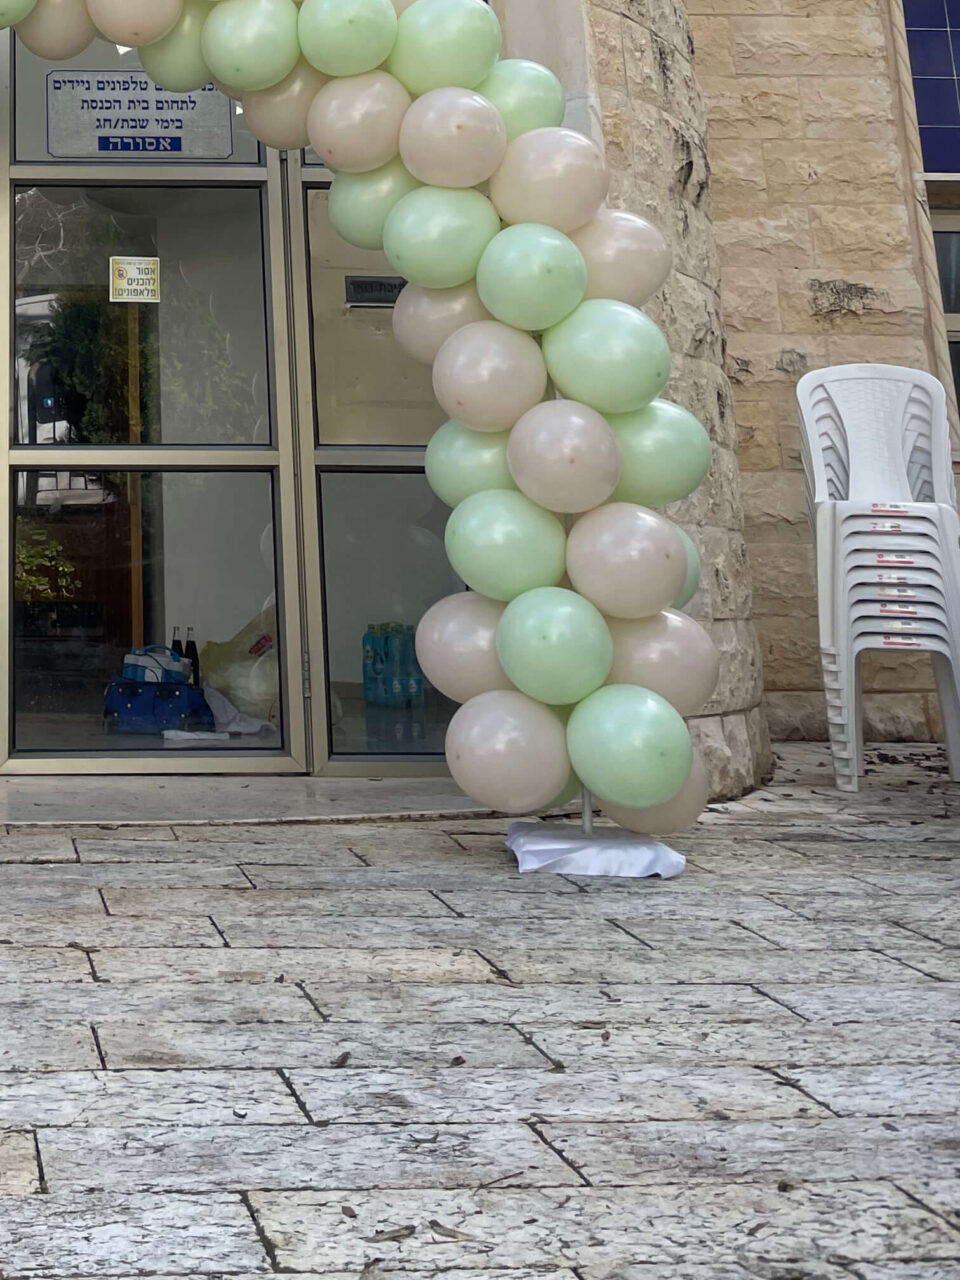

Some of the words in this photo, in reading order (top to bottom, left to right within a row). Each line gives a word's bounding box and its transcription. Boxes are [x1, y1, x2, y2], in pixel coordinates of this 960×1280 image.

[52, 79, 91, 91] ניידים
[96, 76, 149, 91] טלפונים
[80, 98, 122, 111] הכנסת
[127, 99, 149, 111] בית
[155, 96, 197, 111] לתחום
[95, 117, 149, 130] שבת/חג
[154, 118, 184, 130] בימי
[109, 137, 172, 151] אסורה
[136, 267, 155, 276] אסור
[127, 277, 155, 286] להכניס
